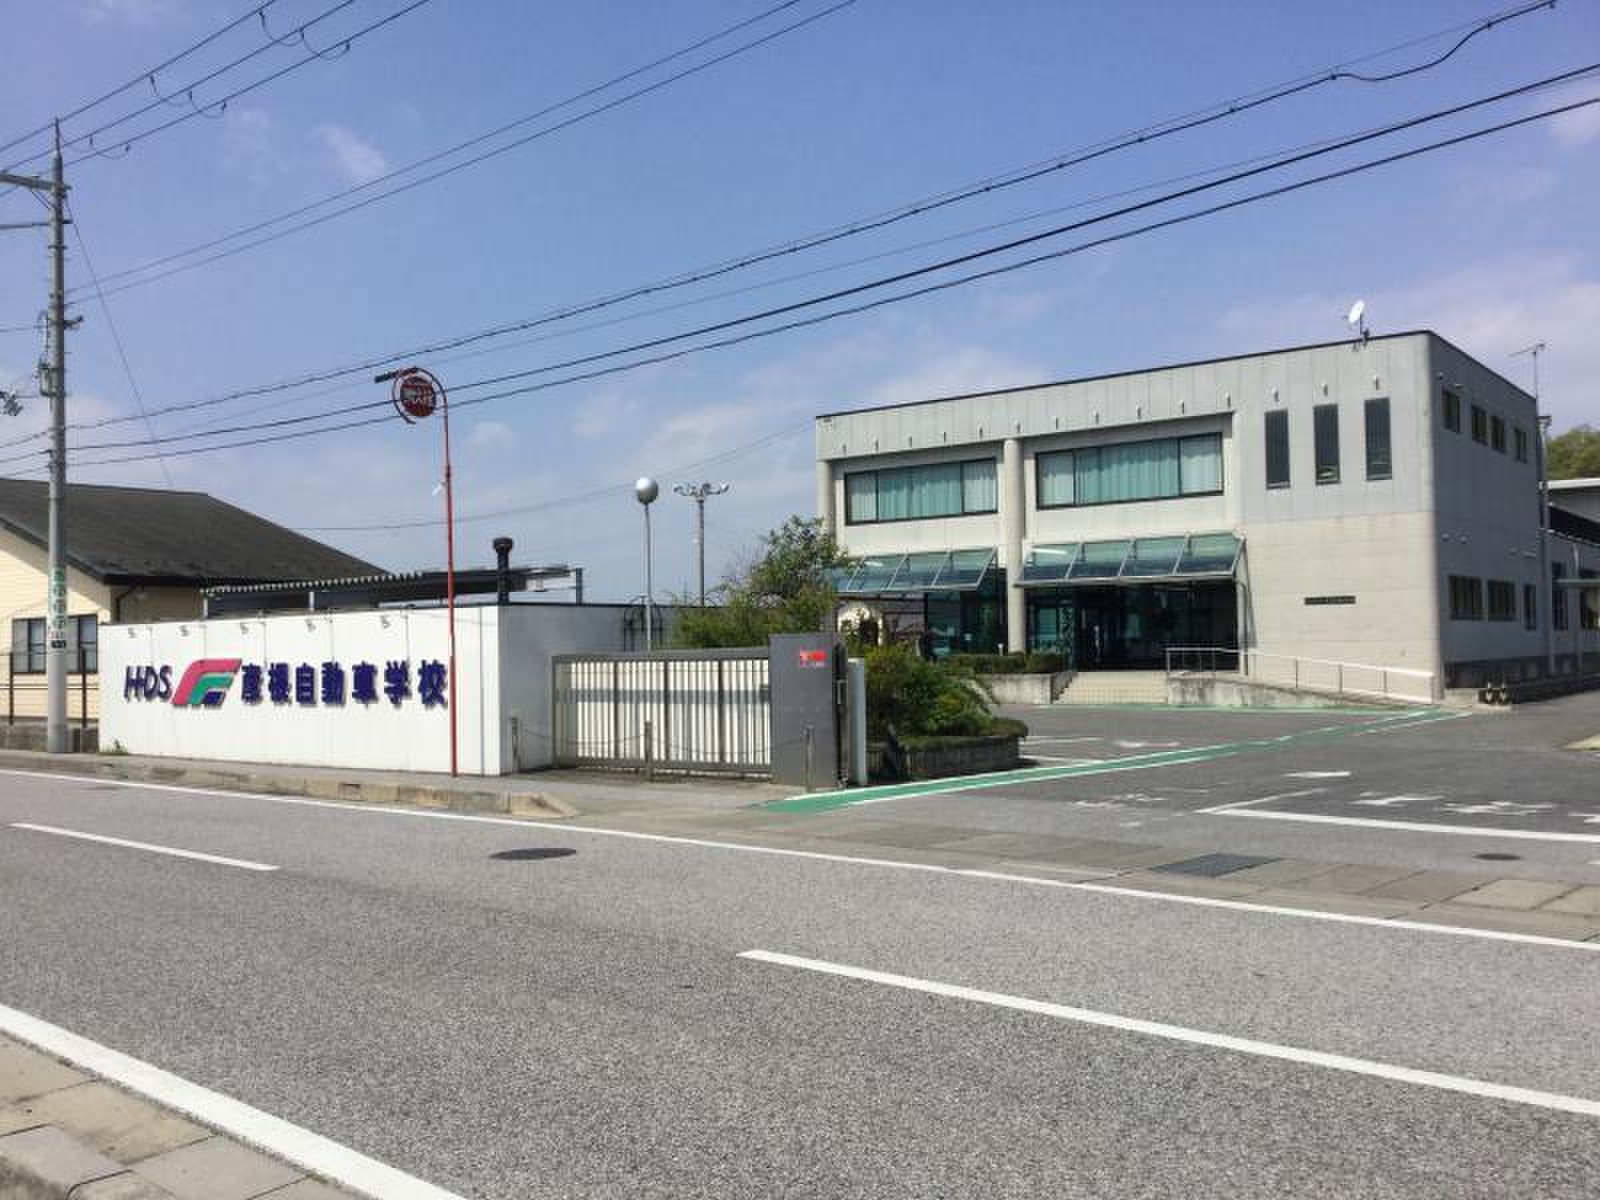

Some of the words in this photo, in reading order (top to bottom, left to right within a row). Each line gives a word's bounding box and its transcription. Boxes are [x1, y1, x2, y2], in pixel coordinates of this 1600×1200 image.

[124, 665, 172, 702] HDS
[241, 659, 448, 706] 彦根自動車学校
